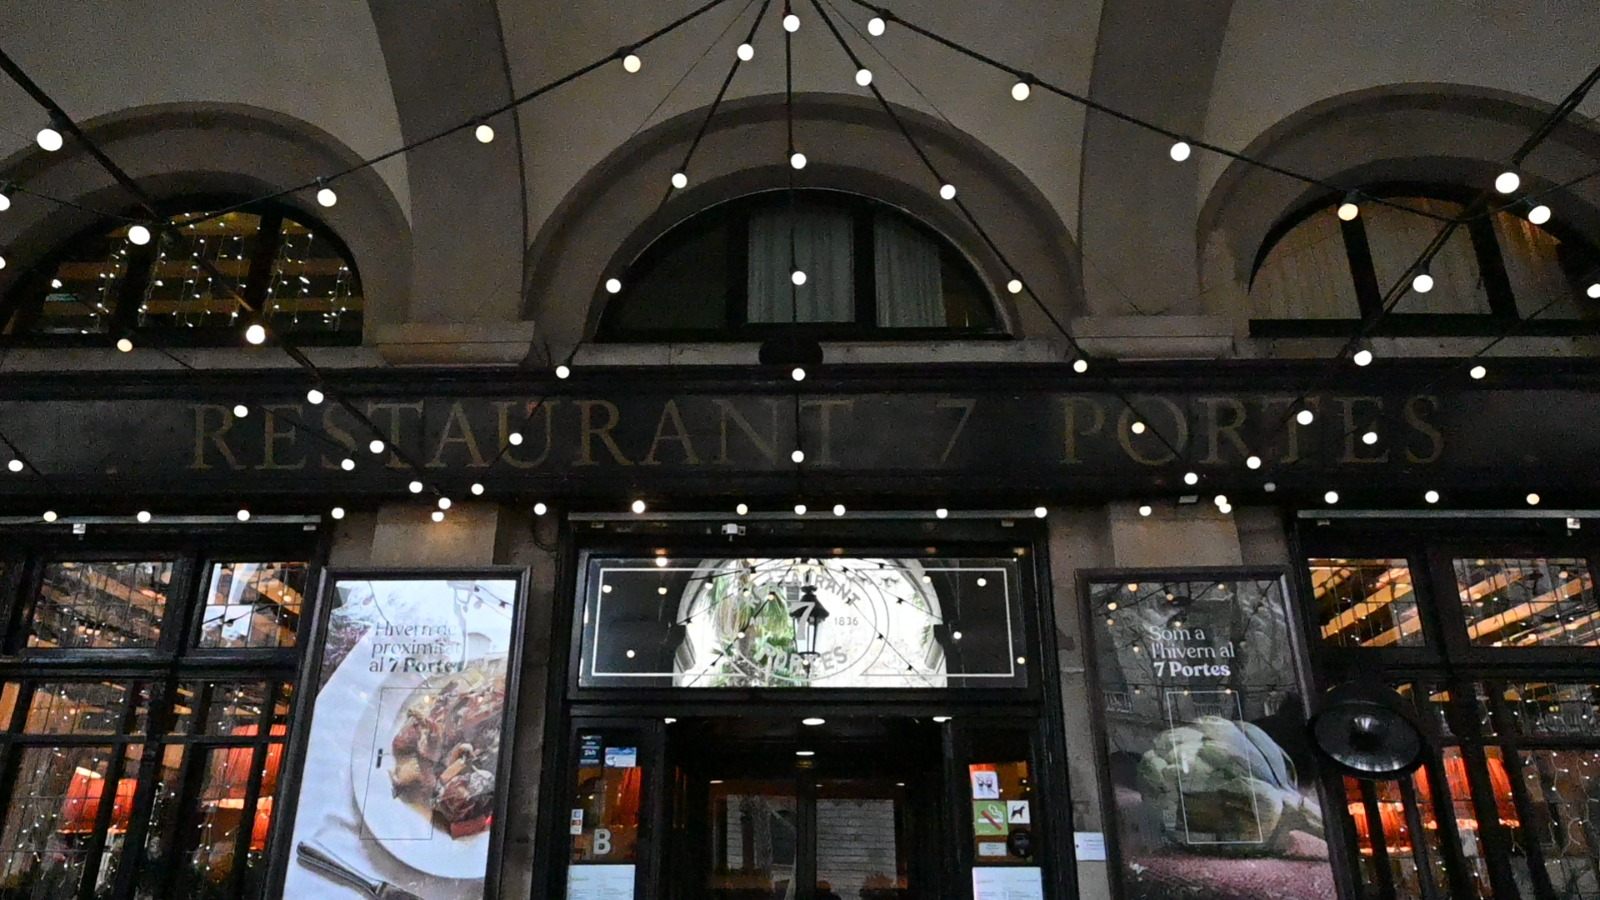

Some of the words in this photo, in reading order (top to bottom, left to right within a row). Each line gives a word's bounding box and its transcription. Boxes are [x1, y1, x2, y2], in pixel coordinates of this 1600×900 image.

[189, 398, 855, 471] RESTAURANT
[935, 398, 977, 465] 7
[1057, 394, 1446, 466] PORTES
[375, 621, 432, 637] Hivern
[790, 601, 816, 640] 7
[834, 616, 859, 627] 1836
[1150, 627, 1191, 641] Som
[1194, 628, 1206, 641] a
[1151, 642, 1216, 659] l'hivern
[1219, 642, 1236, 659] al
[369, 657, 384, 673] al
[388, 658, 400, 673] 7
[1153, 662, 1167, 678] 7
[1169, 661, 1232, 678] Portes
[593, 828, 612, 855] B
